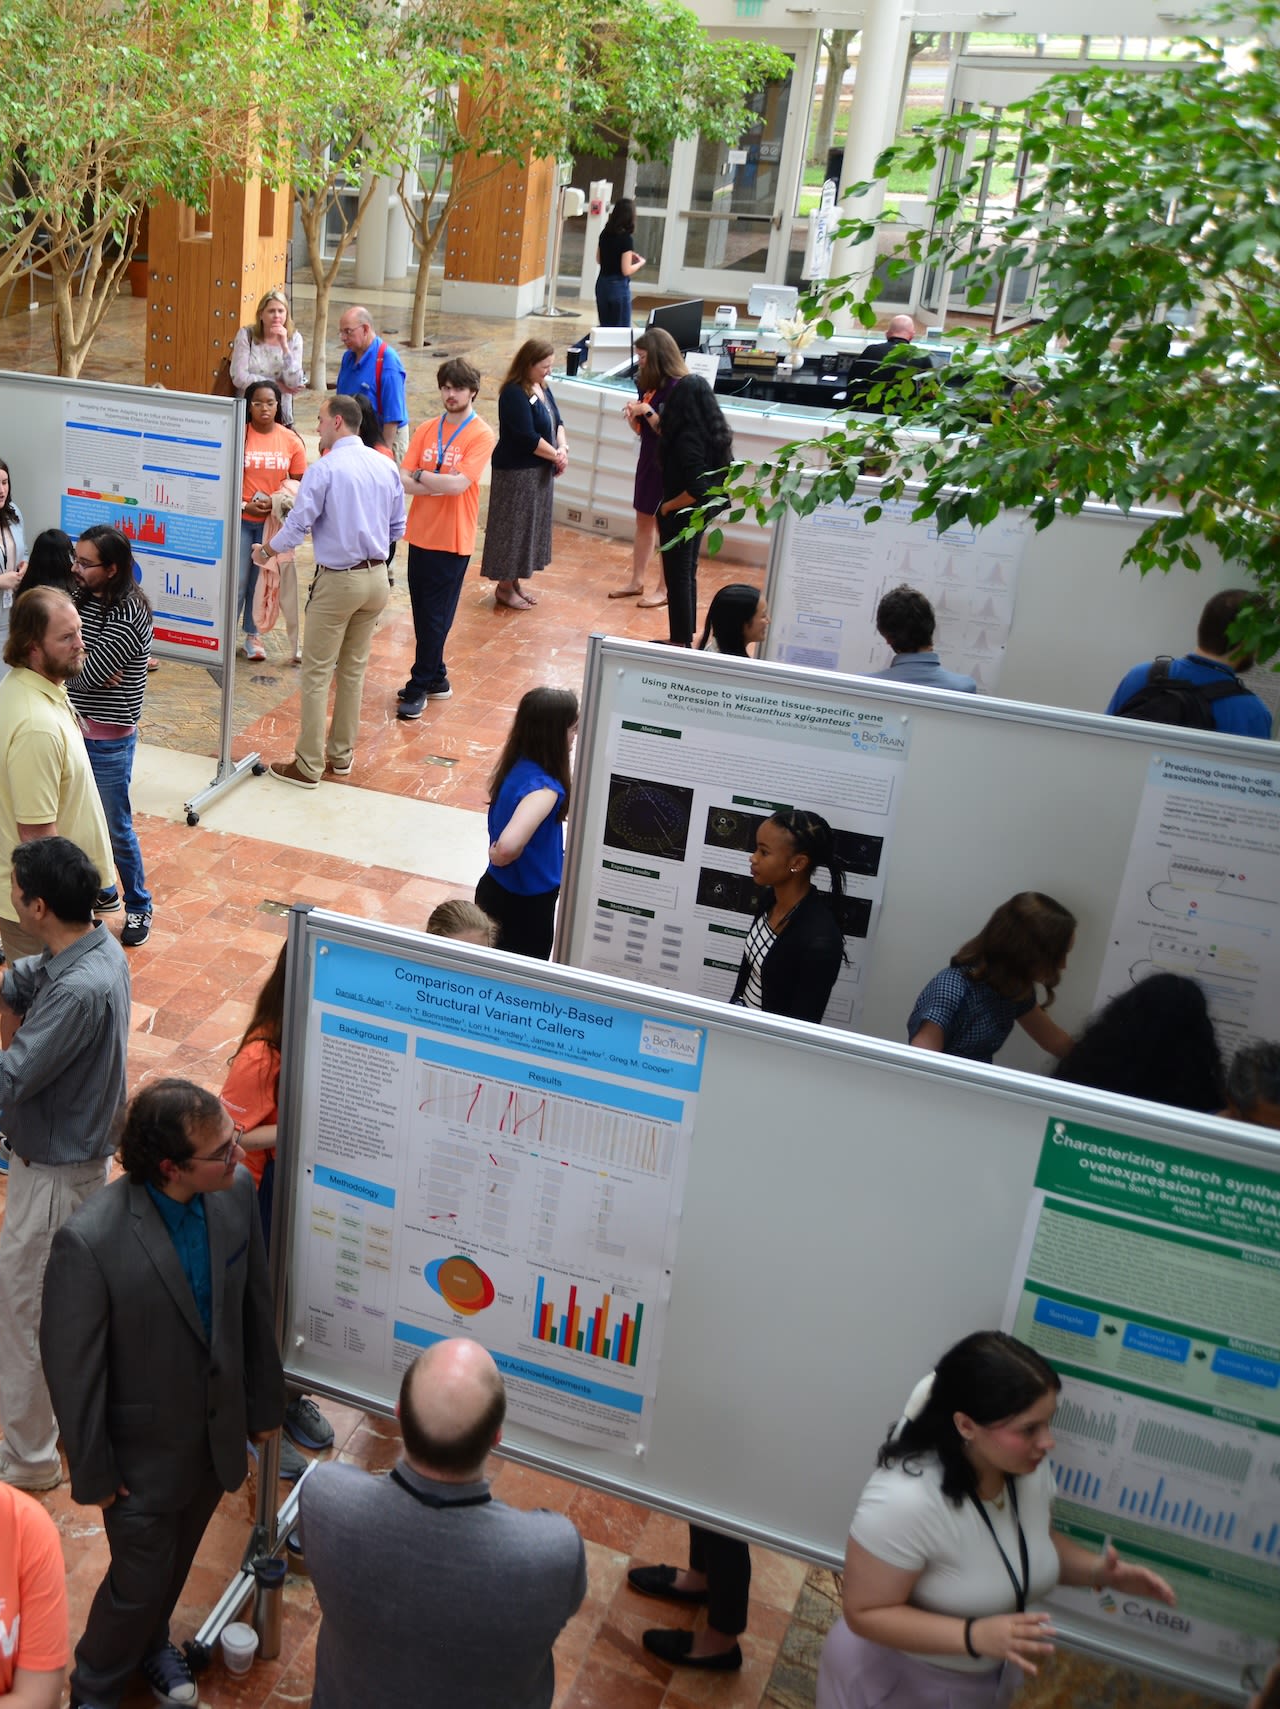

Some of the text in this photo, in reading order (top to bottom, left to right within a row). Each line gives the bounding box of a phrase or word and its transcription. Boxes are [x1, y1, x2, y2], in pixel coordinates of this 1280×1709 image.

[245, 456, 290, 470] STEM
[642, 677, 883, 722] Using RNAscope to visualize tissue-specific gene
[667, 694, 850, 728] expression in Miscanthus xgiganteus
[1162, 774, 1219, 789] associations
[1221, 784, 1246, 796] using
[1165, 762, 1211, 779] Predicting
[395, 968, 613, 1029] Comparison of Assembly-Based
[416, 990, 479, 1015] Structural
[485, 1006, 531, 1027] Variant
[536, 1018, 584, 1040] Callers
[339, 1024, 388, 1042] Background
[608, 1052, 628, 1065] Greg
[528, 1072, 562, 1088] Results
[1052, 1133, 1166, 1176] Characterizing
[1170, 1164, 1221, 1186] starch
[330, 1176, 379, 1199] Methodology
[1079, 1158, 1201, 1197] overexpression
[1205, 1189, 1236, 1206] and
[509, 1361, 592, 1393] Acknowledgements
[1122, 1601, 1192, 1633] CABBI
